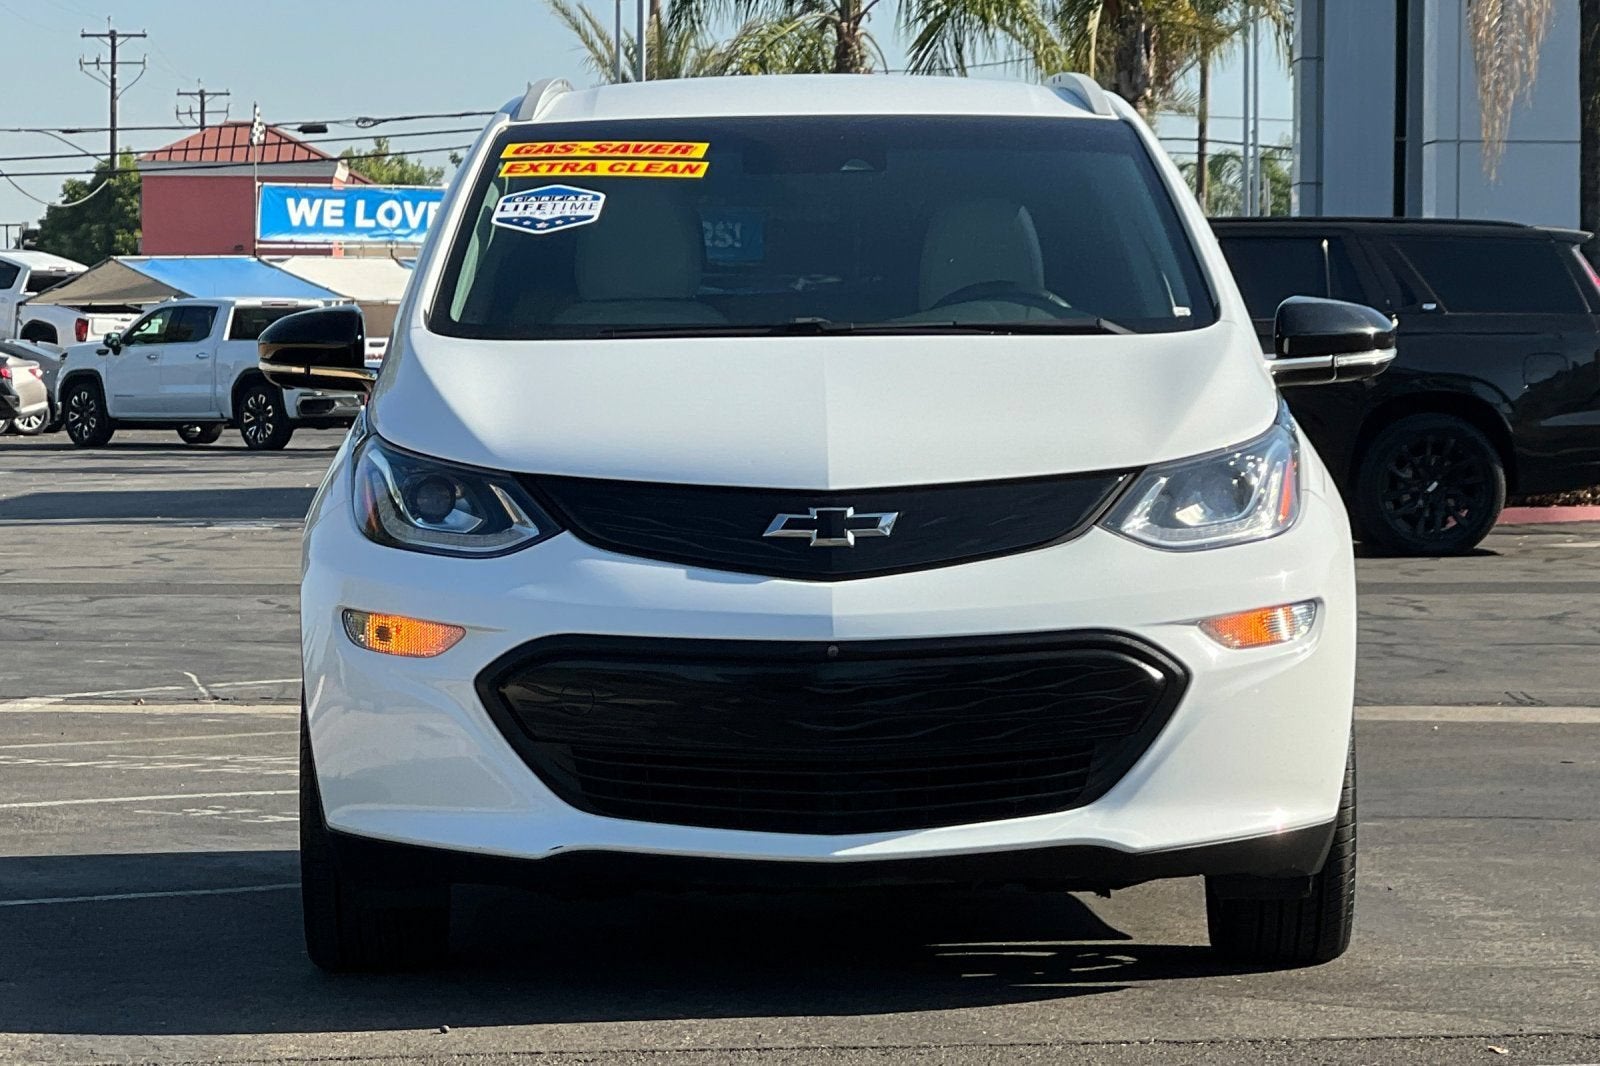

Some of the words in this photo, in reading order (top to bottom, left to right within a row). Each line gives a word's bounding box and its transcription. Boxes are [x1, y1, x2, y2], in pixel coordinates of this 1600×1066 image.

[512, 143, 695, 155] GAS-SAVER
[504, 162, 599, 174] EXTRA
[607, 162, 703, 175] CLEAN
[286, 197, 345, 228] WE
[500, 202, 599, 212] LIFETIME
